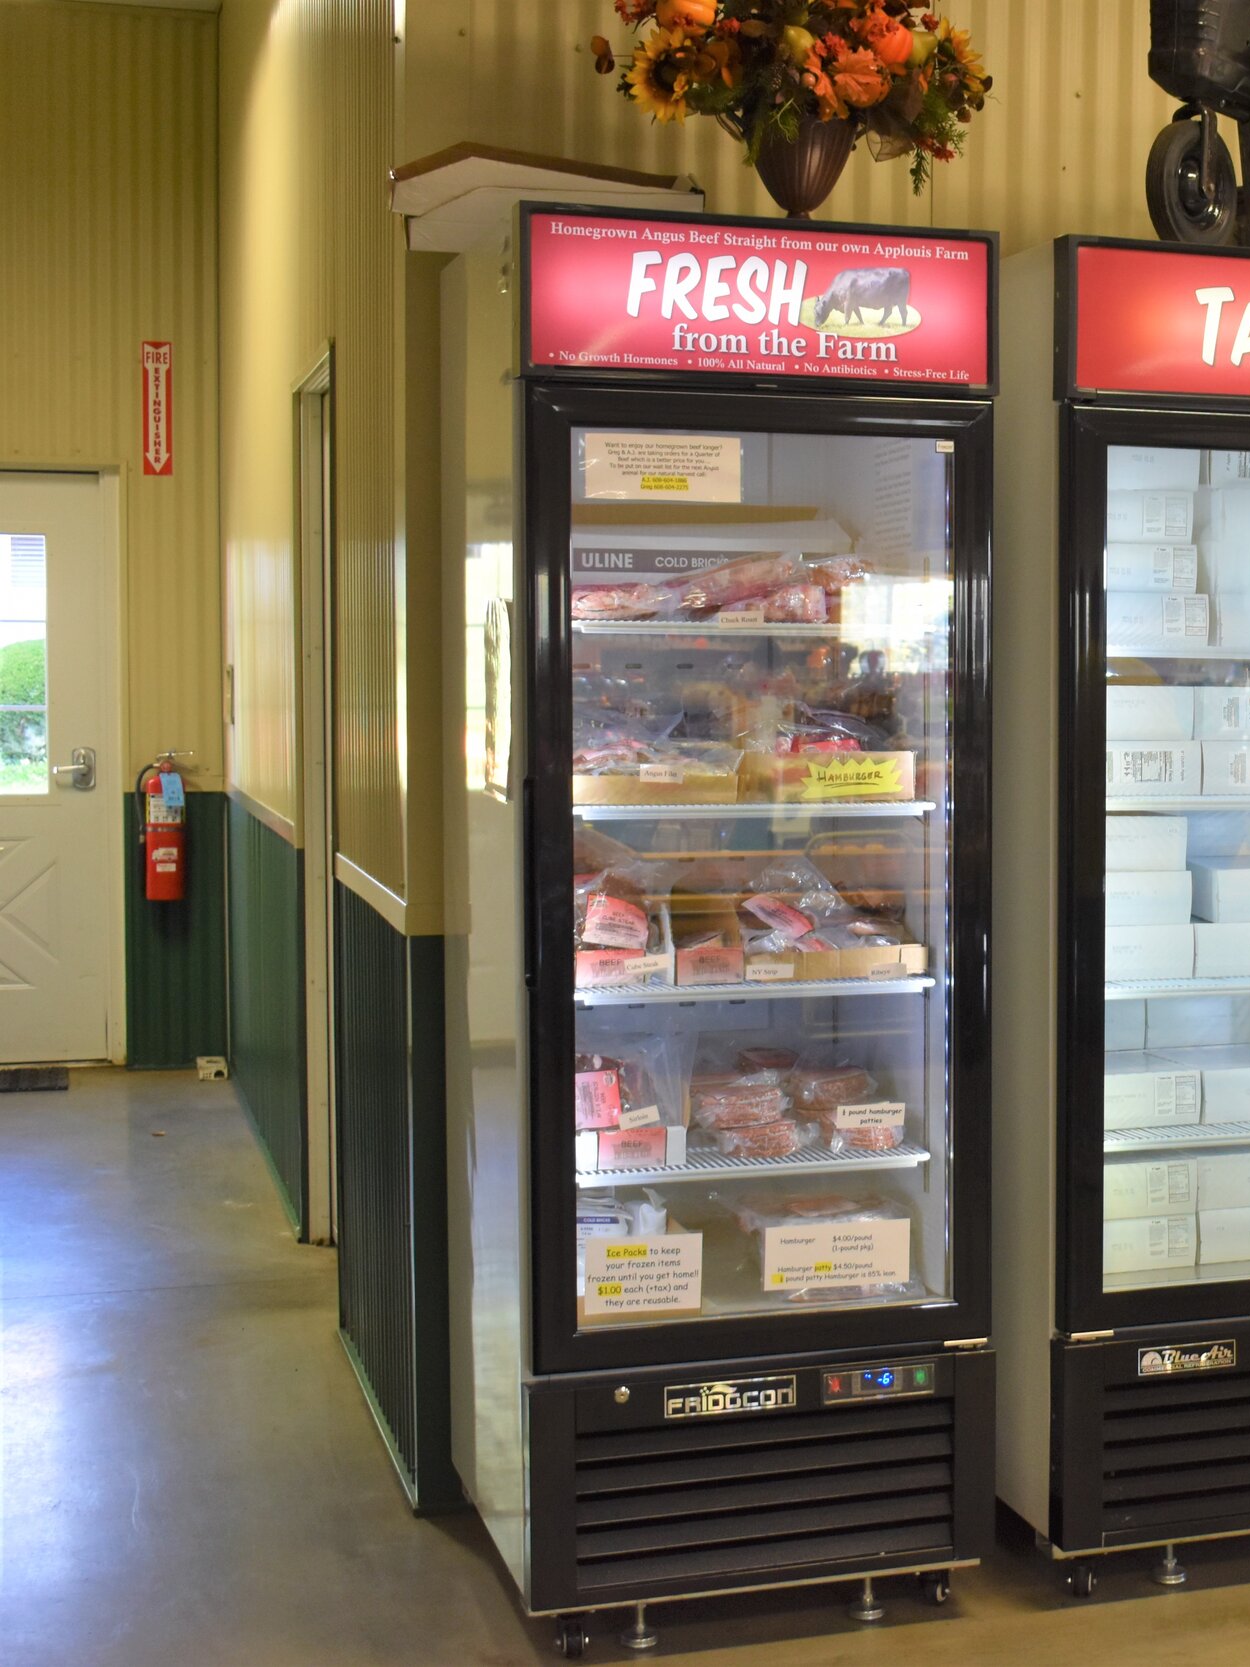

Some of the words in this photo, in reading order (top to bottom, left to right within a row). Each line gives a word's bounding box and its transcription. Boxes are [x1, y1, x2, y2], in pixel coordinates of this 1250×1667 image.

[551, 222, 638, 240] Homegrown
[642, 228, 685, 244] Angus
[689, 230, 720, 244] Beef
[724, 232, 778, 250] Straight
[781, 236, 812, 250] from
[816, 242, 838, 252] our
[842, 244, 870, 254] own
[874, 242, 932, 259] Applouis
[936, 246, 968, 260] Farm
[627, 250, 808, 326] FRESH
[672, 323, 749, 354] from
[758, 328, 807, 356] the
[816, 332, 898, 362] Farm
[146, 351, 168, 365] FIRE
[559, 351, 576, 361] No
[579, 352, 620, 364] Growth
[624, 354, 678, 366] Hormones
[698, 358, 724, 368] 100%
[728, 359, 744, 369] All
[747, 361, 784, 372] Natural
[804, 362, 819, 372] No
[822, 364, 877, 376] Antibiotics
[894, 366, 946, 379] Stress-Free
[950, 370, 970, 380] Life
[153, 366, 162, 464] EXTINGUISHER
[582, 552, 634, 568] ULINE
[655, 556, 688, 568] COLD
[817, 770, 883, 782] HAMBURGER
[600, 958, 621, 967] BEEF
[626, 962, 642, 970] Cube
[869, 1108, 902, 1116] hamburger
[621, 1140, 642, 1148] BEEF
[780, 1237, 816, 1246] Hamburger
[832, 1234, 873, 1243] $4.00/pound
[606, 1248, 621, 1258] Ice
[624, 1248, 646, 1257] Packs
[661, 1246, 680, 1257] keep
[860, 1243, 874, 1252] pkg)
[606, 1263, 624, 1272] your
[628, 1260, 656, 1268] frozen
[658, 1258, 681, 1266] items
[778, 1265, 813, 1274] Hamburger
[814, 1263, 832, 1272] patty
[834, 1262, 873, 1270] $4.50/pound
[588, 1274, 616, 1283] frozen
[618, 1273, 637, 1282] until
[640, 1274, 654, 1282] you
[656, 1272, 670, 1281] get
[672, 1270, 699, 1278] home!!
[786, 1274, 804, 1284] pound
[806, 1274, 823, 1282] patty
[824, 1272, 860, 1280] Hamburger
[598, 1285, 622, 1296] $1.00
[624, 1285, 644, 1294] each
[646, 1284, 672, 1294] (+tax)
[673, 1282, 688, 1291] and
[606, 1298, 624, 1308] they
[643, 1296, 681, 1305] reusable.
[1162, 1349, 1200, 1364] Blue
[1202, 1345, 1233, 1362] Air
